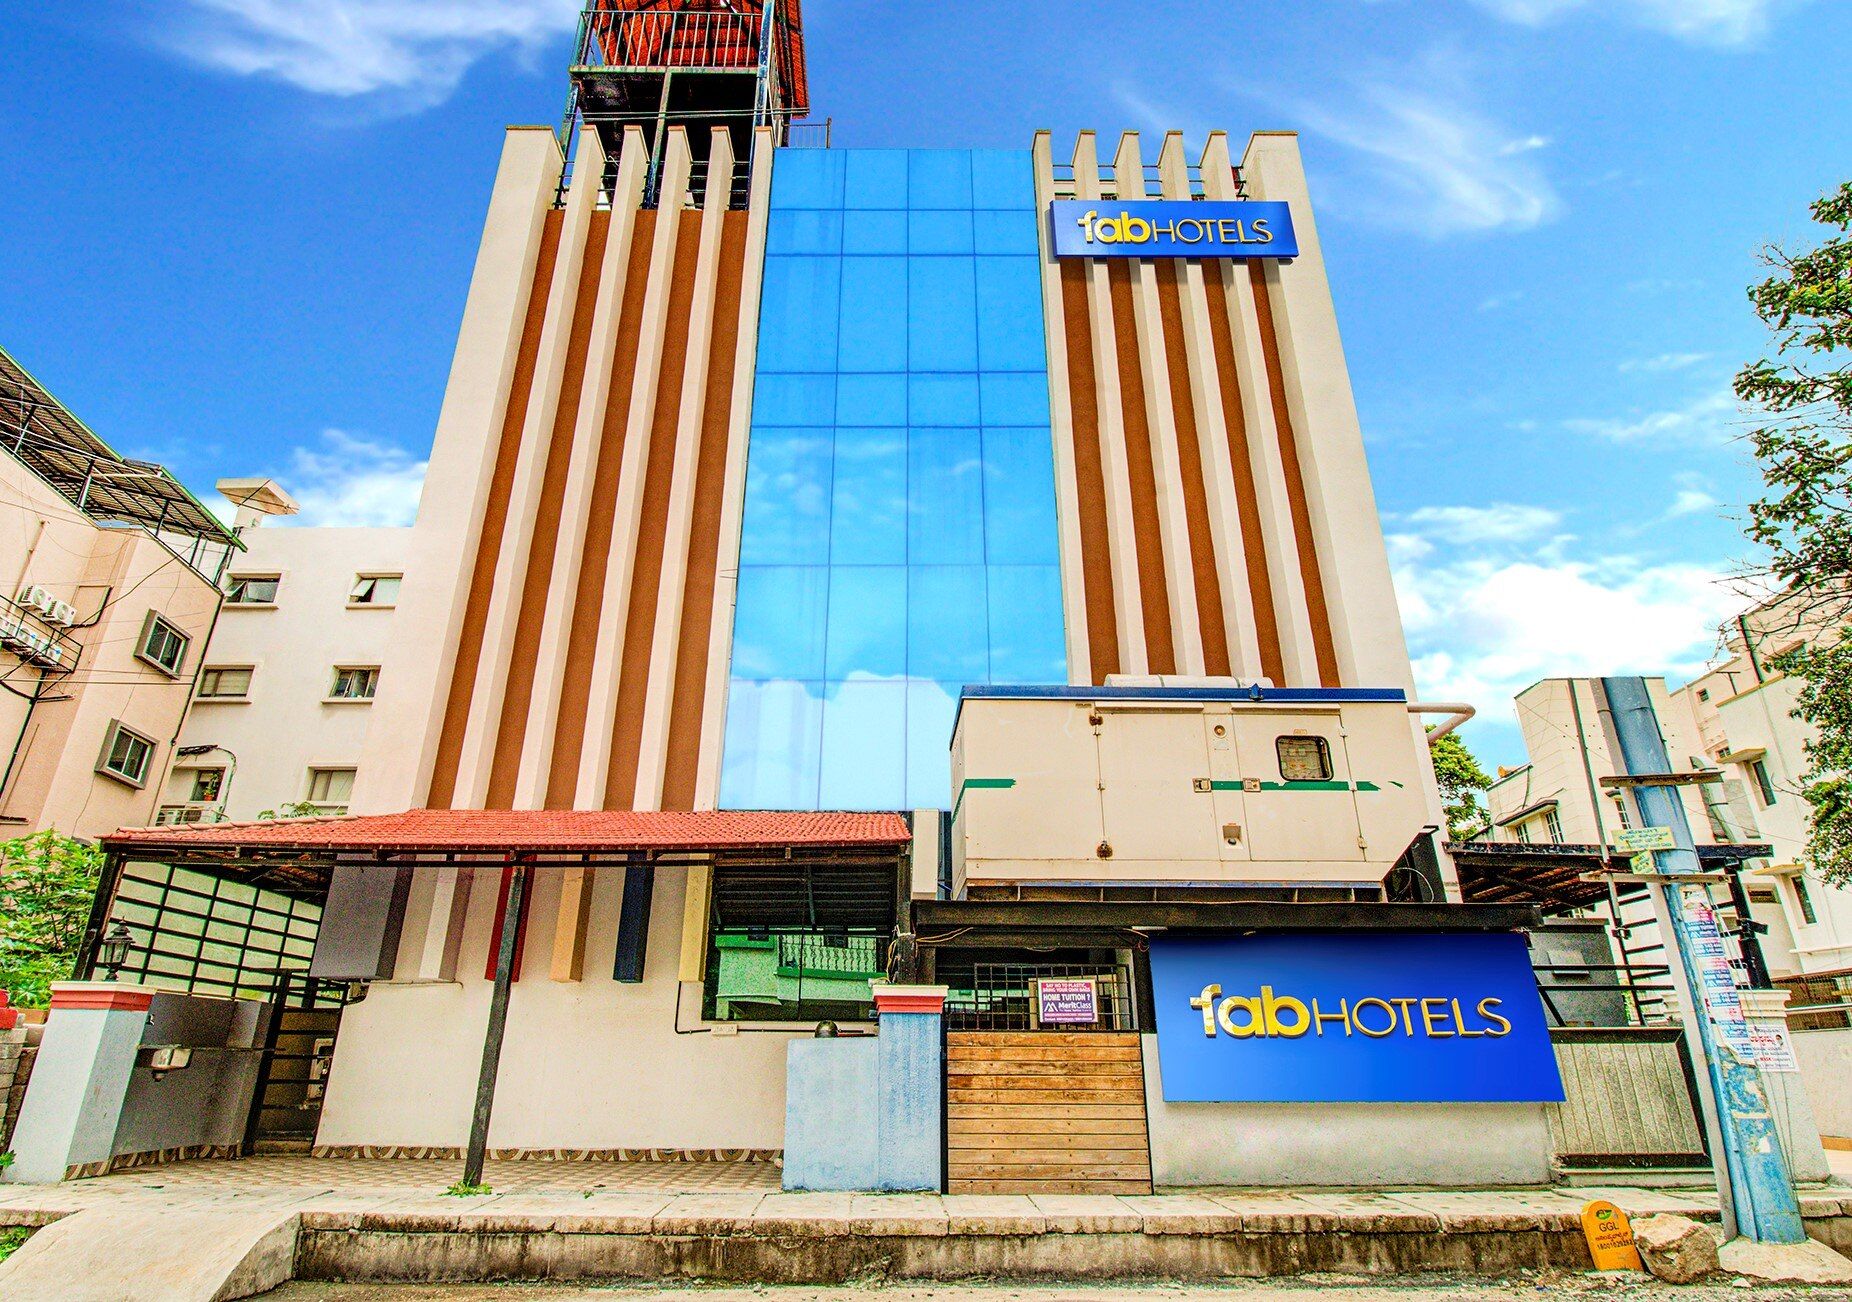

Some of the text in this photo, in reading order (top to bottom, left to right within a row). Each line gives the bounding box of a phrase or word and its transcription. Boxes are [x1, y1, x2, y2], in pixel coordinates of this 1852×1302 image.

[1043, 993, 1061, 1001] HOME
[1061, 993, 1086, 1001] TUITION
[1058, 1001, 1092, 1009] MeritClass
[1599, 1221, 1620, 1232] GGL
